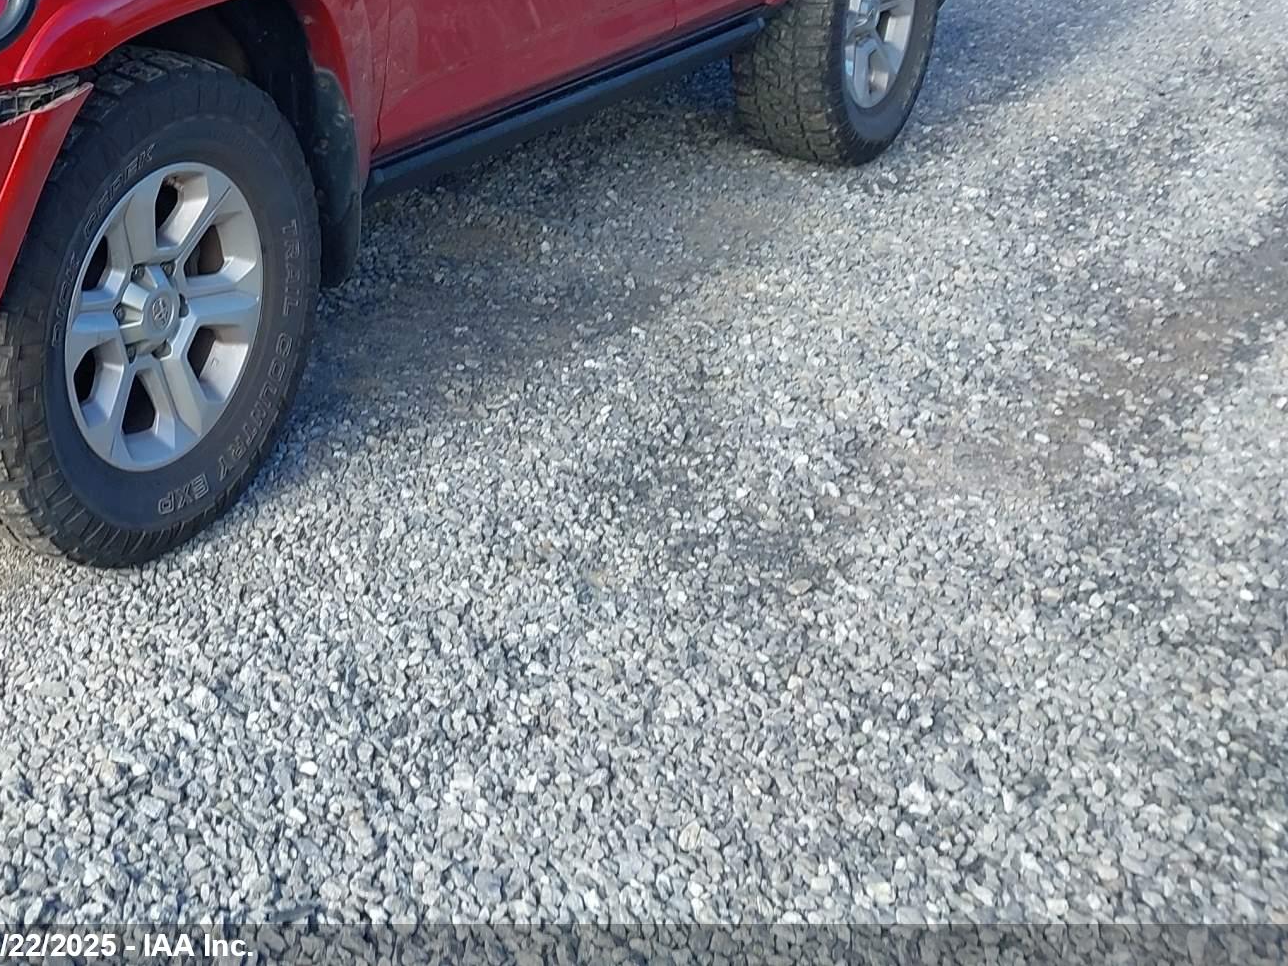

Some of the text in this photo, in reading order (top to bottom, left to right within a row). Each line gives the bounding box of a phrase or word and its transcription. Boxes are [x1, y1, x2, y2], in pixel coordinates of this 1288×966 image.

[158, 219, 301, 516] TRAIL COUNTRY EXP
